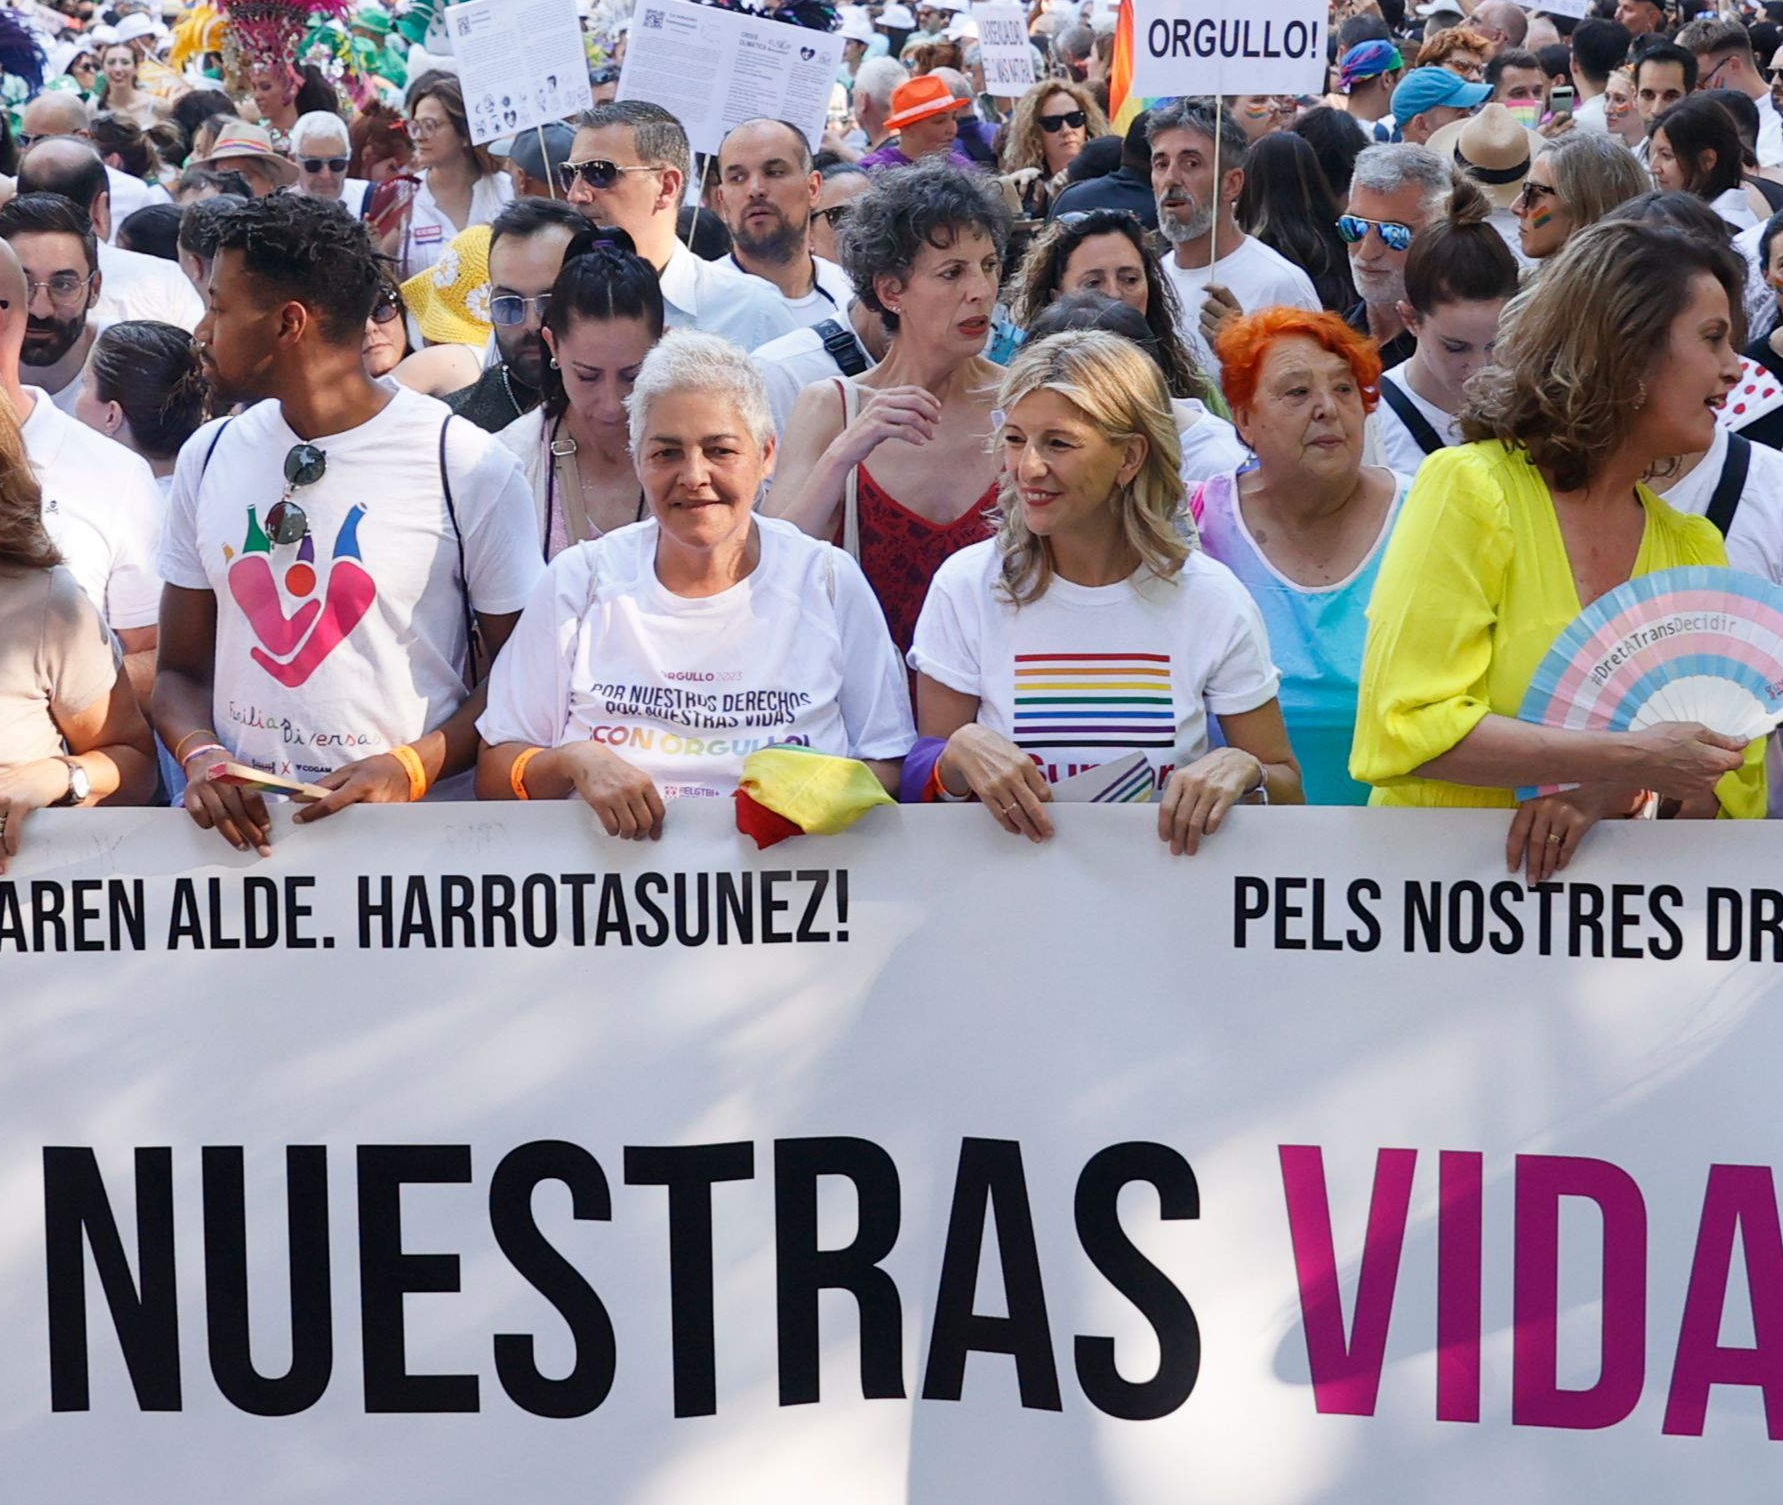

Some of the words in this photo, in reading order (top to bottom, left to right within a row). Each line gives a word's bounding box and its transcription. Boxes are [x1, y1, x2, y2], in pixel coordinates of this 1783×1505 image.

[1147, 17, 1318, 59] ORGULLO!
[1589, 614, 1738, 688] #DretATransDecidir
[632, 685, 717, 712] NUESTROS
[723, 690, 812, 713] DERECHOS
[303, 765, 333, 774] COGAM
[168, 877, 335, 950] ALDE.
[358, 870, 849, 949] HARROTASUNEZ!
[1235, 877, 1382, 953] PELS
[1405, 881, 1684, 961] NOSTRES
[43, 1137, 1201, 1421] NUESTRAS
